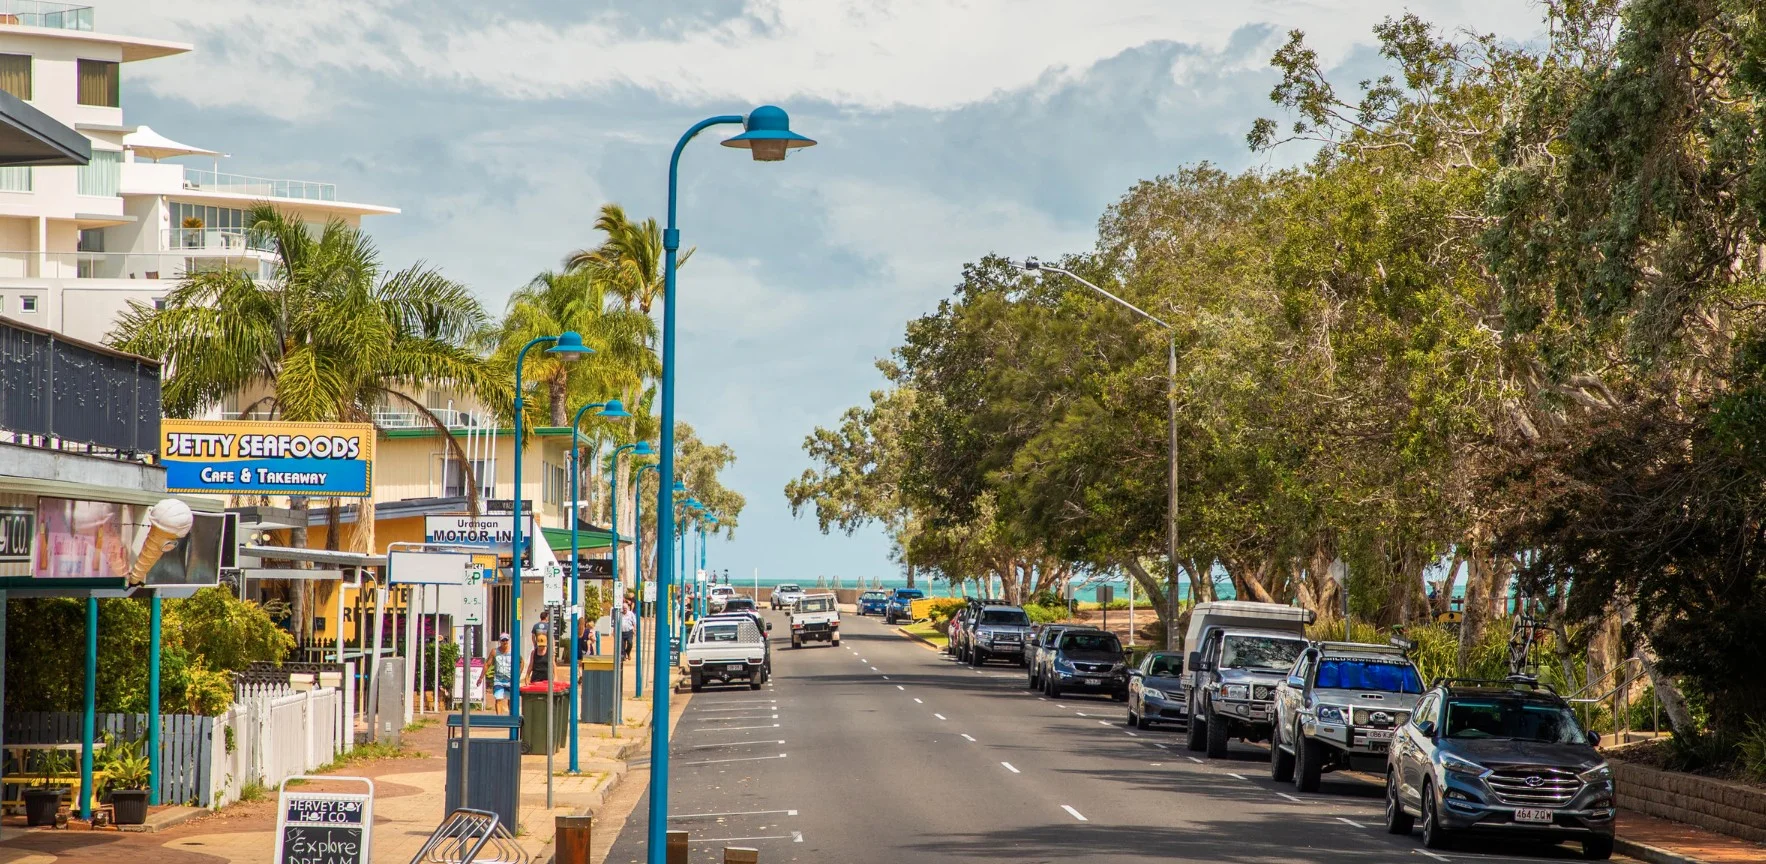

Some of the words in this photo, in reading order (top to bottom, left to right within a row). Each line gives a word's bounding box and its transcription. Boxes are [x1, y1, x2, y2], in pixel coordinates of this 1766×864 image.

[167, 433, 236, 456] JETTY
[238, 435, 360, 460] SEAFOODS
[201, 466, 235, 483] CAFE
[240, 468, 251, 483] &
[257, 468, 327, 485] TAKEAWAY
[457, 519, 499, 530] Urangan
[433, 530, 489, 542] MOTOR
[496, 530, 524, 542] IN
[288, 800, 336, 811] HERVEY
[328, 812, 349, 823] CO.
[1516, 810, 1532, 819] 464
[292, 830, 358, 858] Explore
